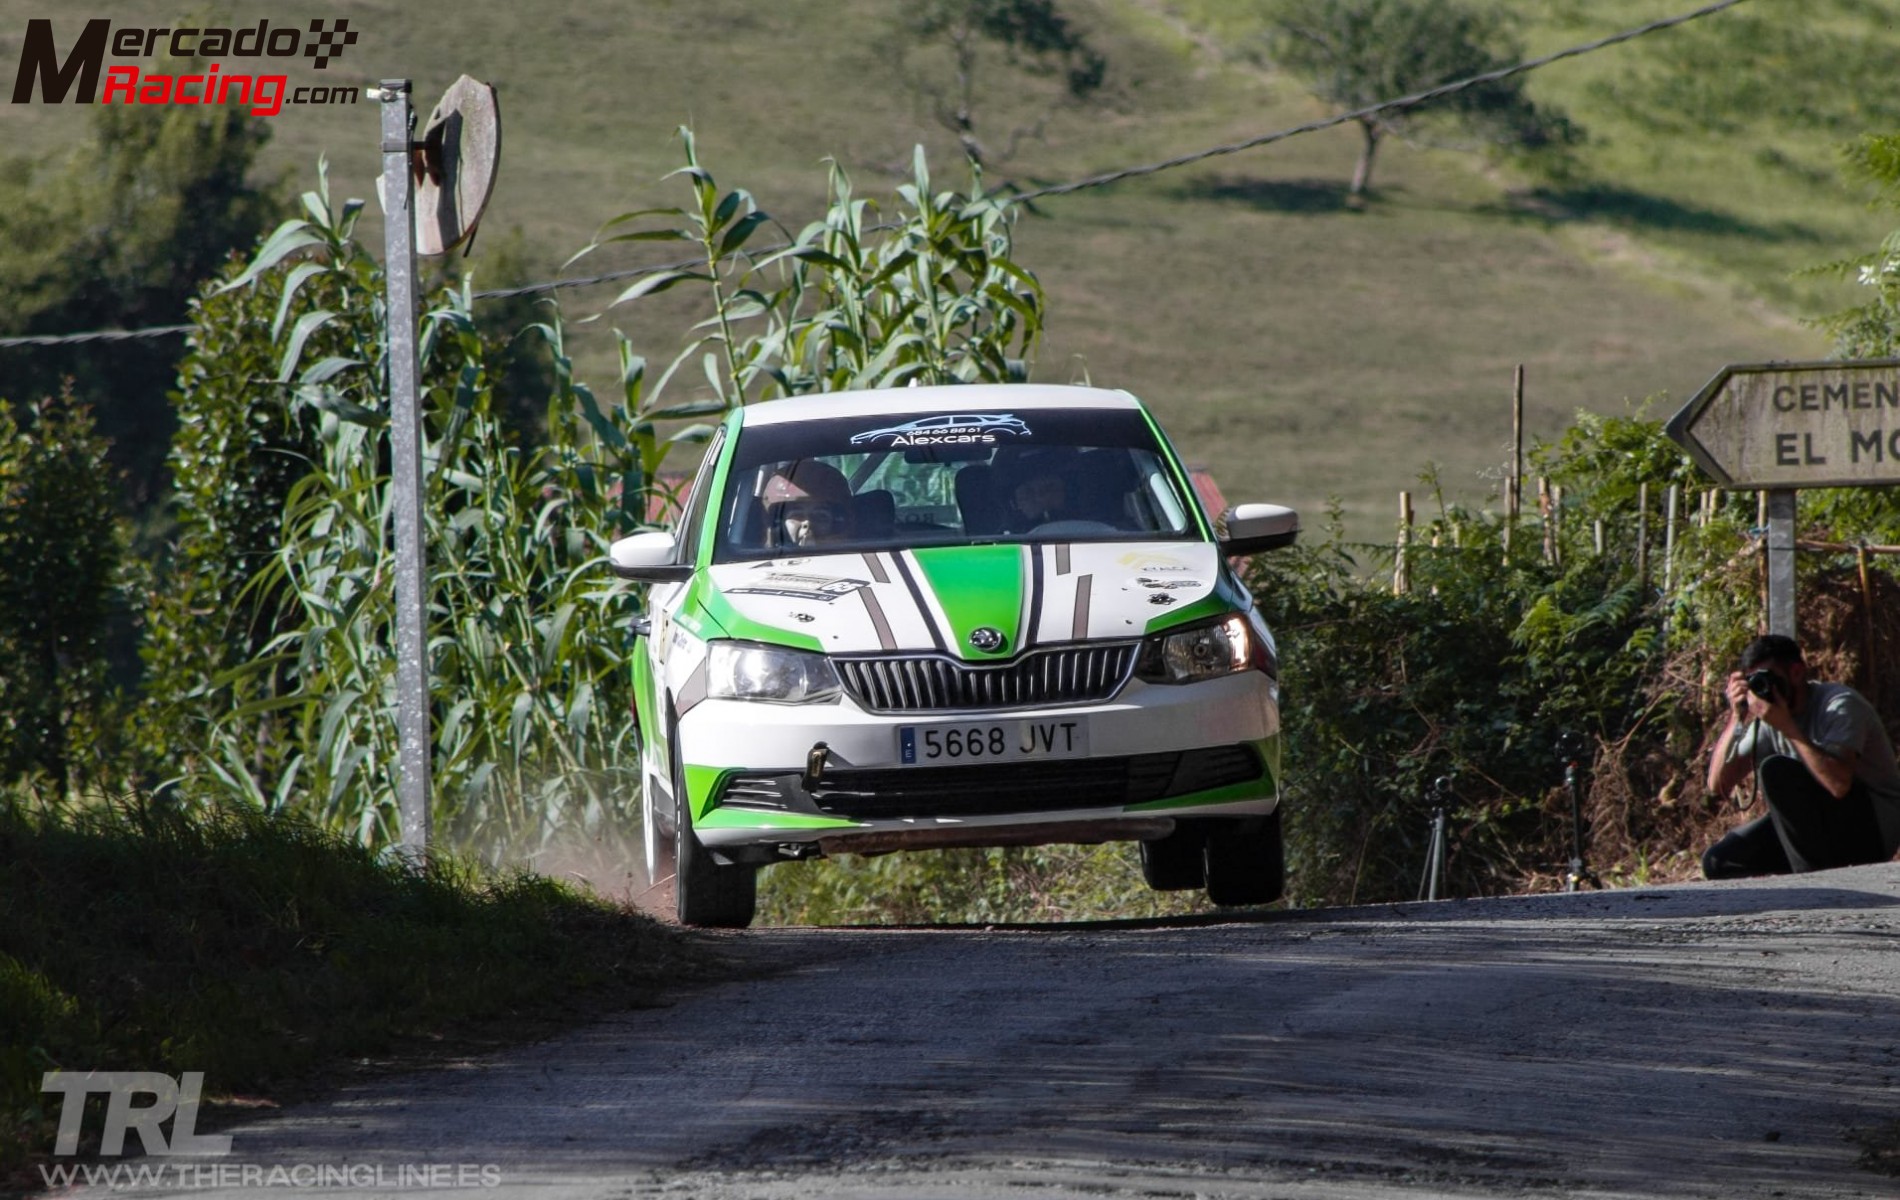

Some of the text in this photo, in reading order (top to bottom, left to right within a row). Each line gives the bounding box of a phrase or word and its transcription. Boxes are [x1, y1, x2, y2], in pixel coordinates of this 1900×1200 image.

[1773, 382, 1898, 412] CEMEN
[891, 434, 996, 447] Alexcars
[1776, 433, 1826, 466] EL
[925, 723, 1077, 758] 5668 JVT
